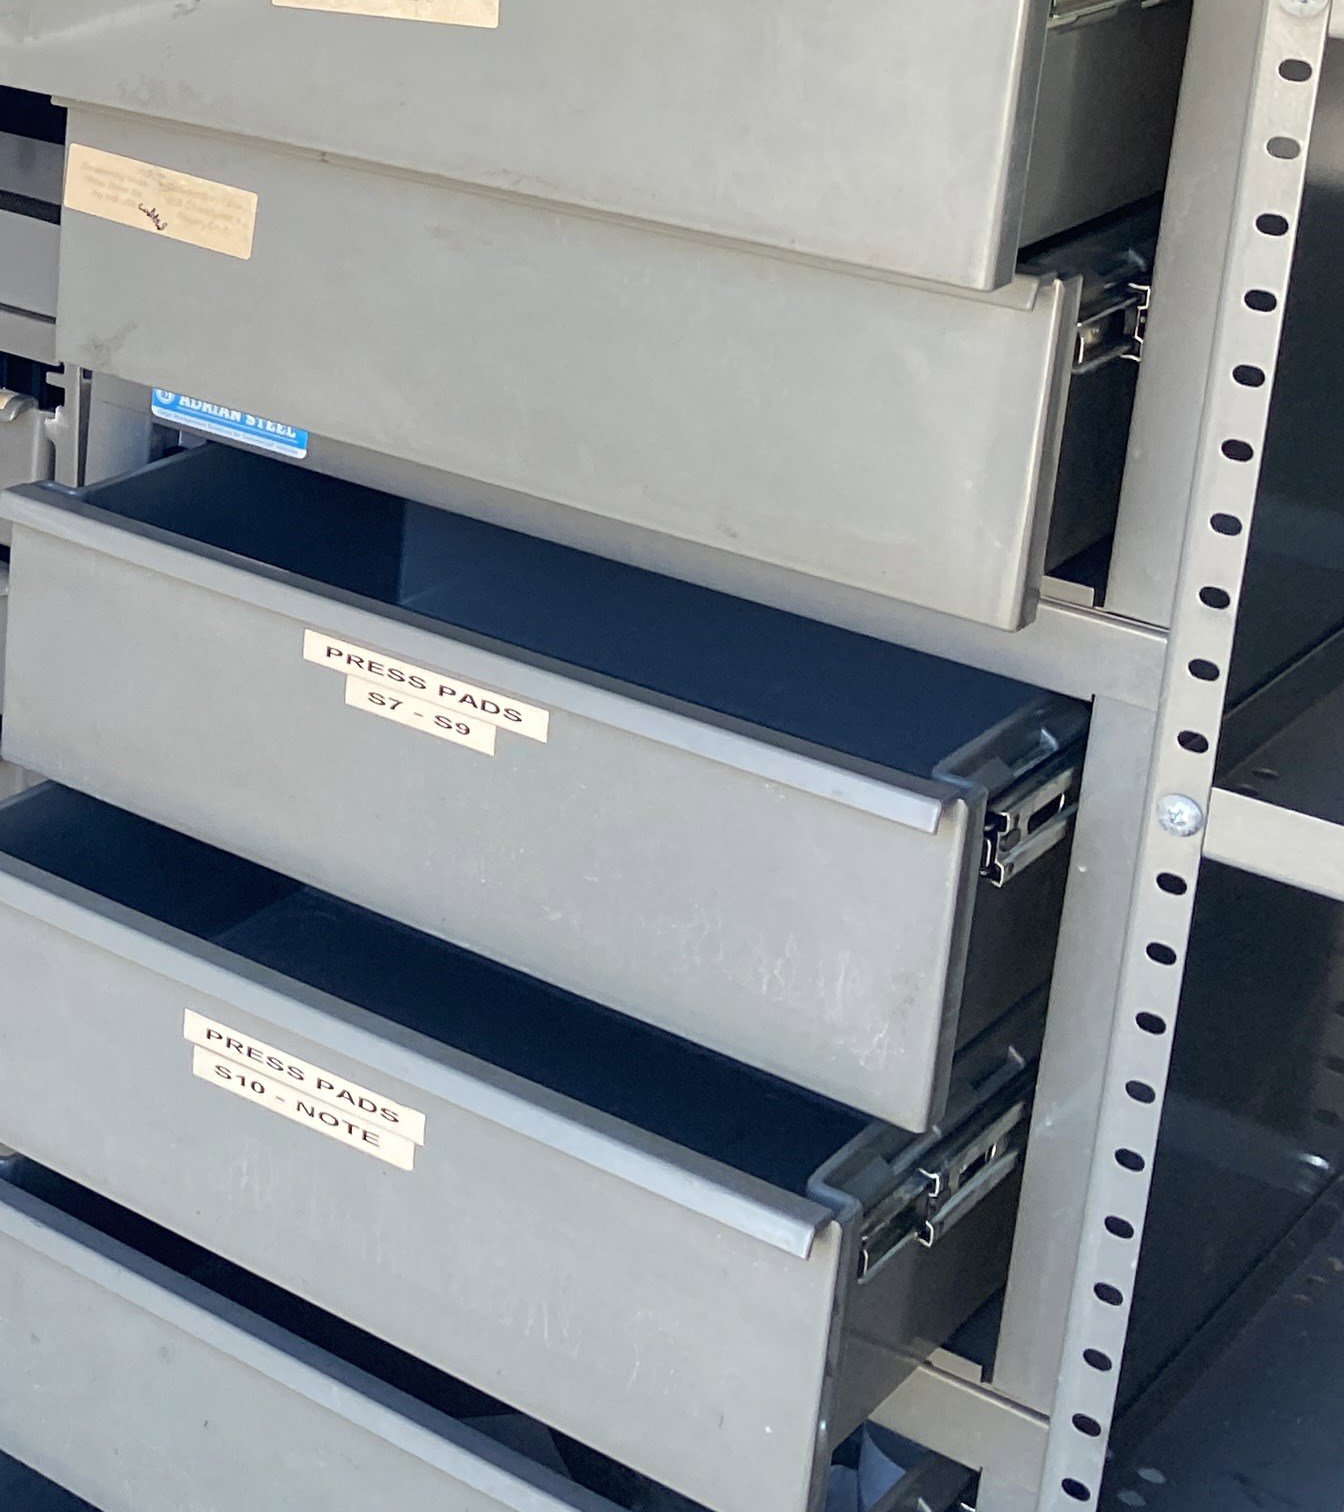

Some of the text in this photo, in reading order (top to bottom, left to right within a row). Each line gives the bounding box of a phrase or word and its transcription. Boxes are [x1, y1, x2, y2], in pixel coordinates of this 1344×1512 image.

[179, 395, 241, 422] ADRIAN
[245, 414, 297, 438] STEEL
[326, 646, 523, 723] PRESS PADS
[368, 691, 403, 710] S7
[434, 714, 471, 736] S9
[206, 1028, 400, 1124] PRESS PADS
[214, 1064, 266, 1095] S10
[296, 1100, 381, 1148] NOTE
